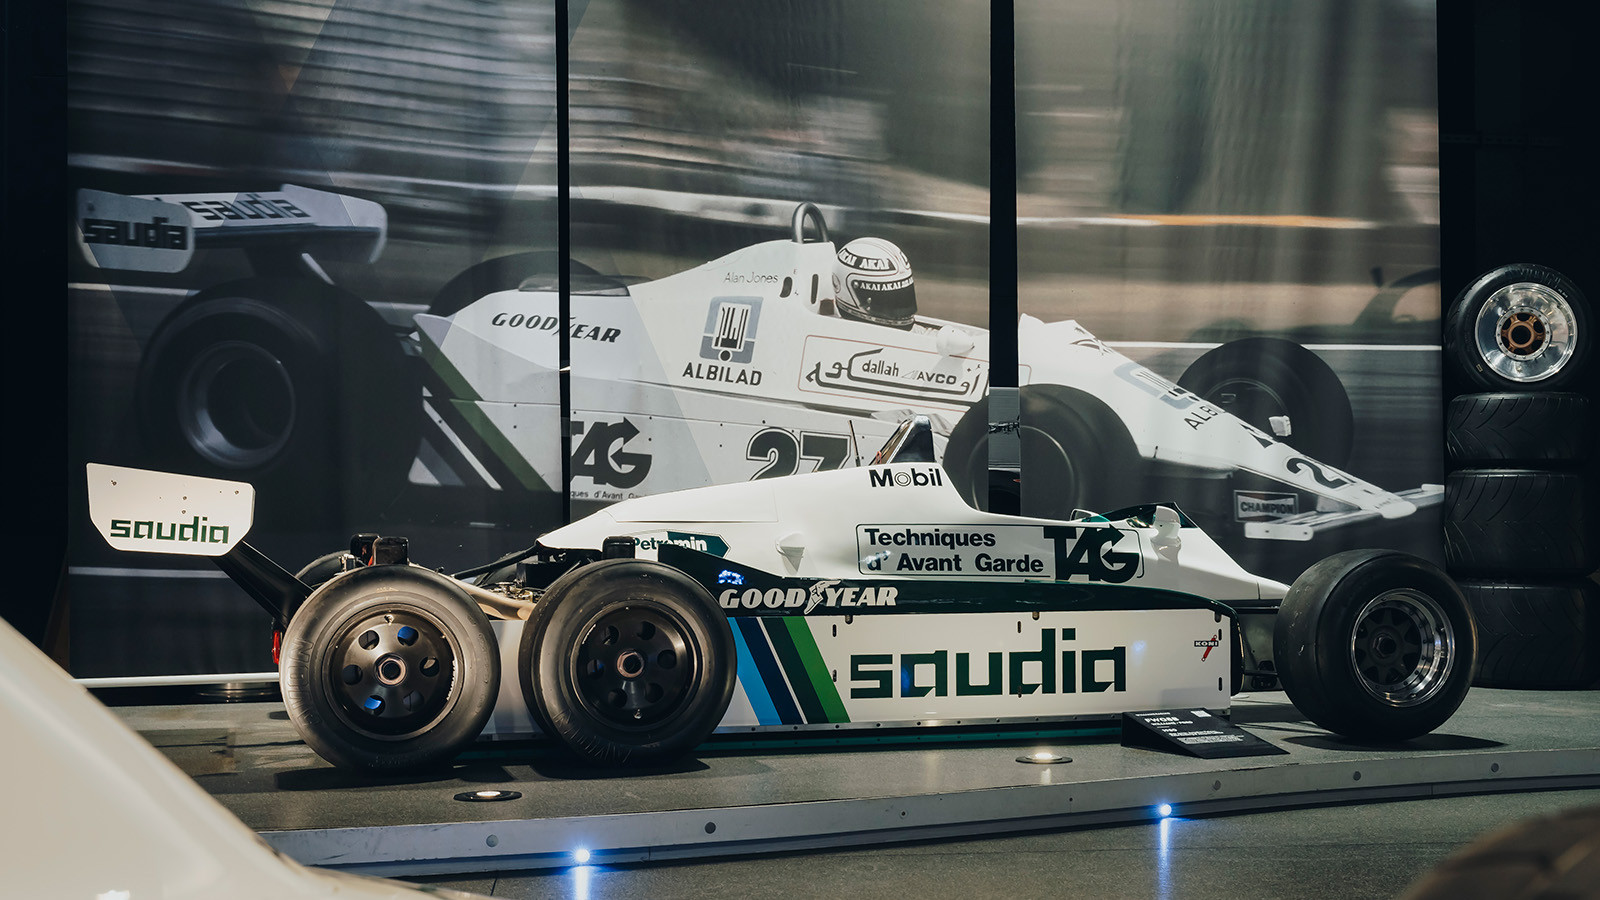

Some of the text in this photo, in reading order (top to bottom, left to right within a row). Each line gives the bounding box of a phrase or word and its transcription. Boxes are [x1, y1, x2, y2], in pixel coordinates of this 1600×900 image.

[181, 194, 311, 220] saudia
[83, 217, 188, 250] saudia
[859, 258, 890, 270] AKAI
[724, 272, 778, 284] Alan Jones
[860, 282, 880, 291] AKAI
[881, 281, 900, 291] AKAI
[491, 312, 622, 343] GOODEAR
[682, 362, 763, 386] ALBILAD
[862, 360, 957, 385] dallah AVCO
[746, 427, 851, 482] 27
[868, 468, 943, 488] Mobil
[1240, 501, 1296, 515] CHAMPION
[110, 516, 229, 544] saudia
[865, 524, 1139, 584] Techniques TAG
[897, 553, 962, 572] Avant
[975, 553, 1044, 573] Garde
[850, 627, 1127, 699] saudia
